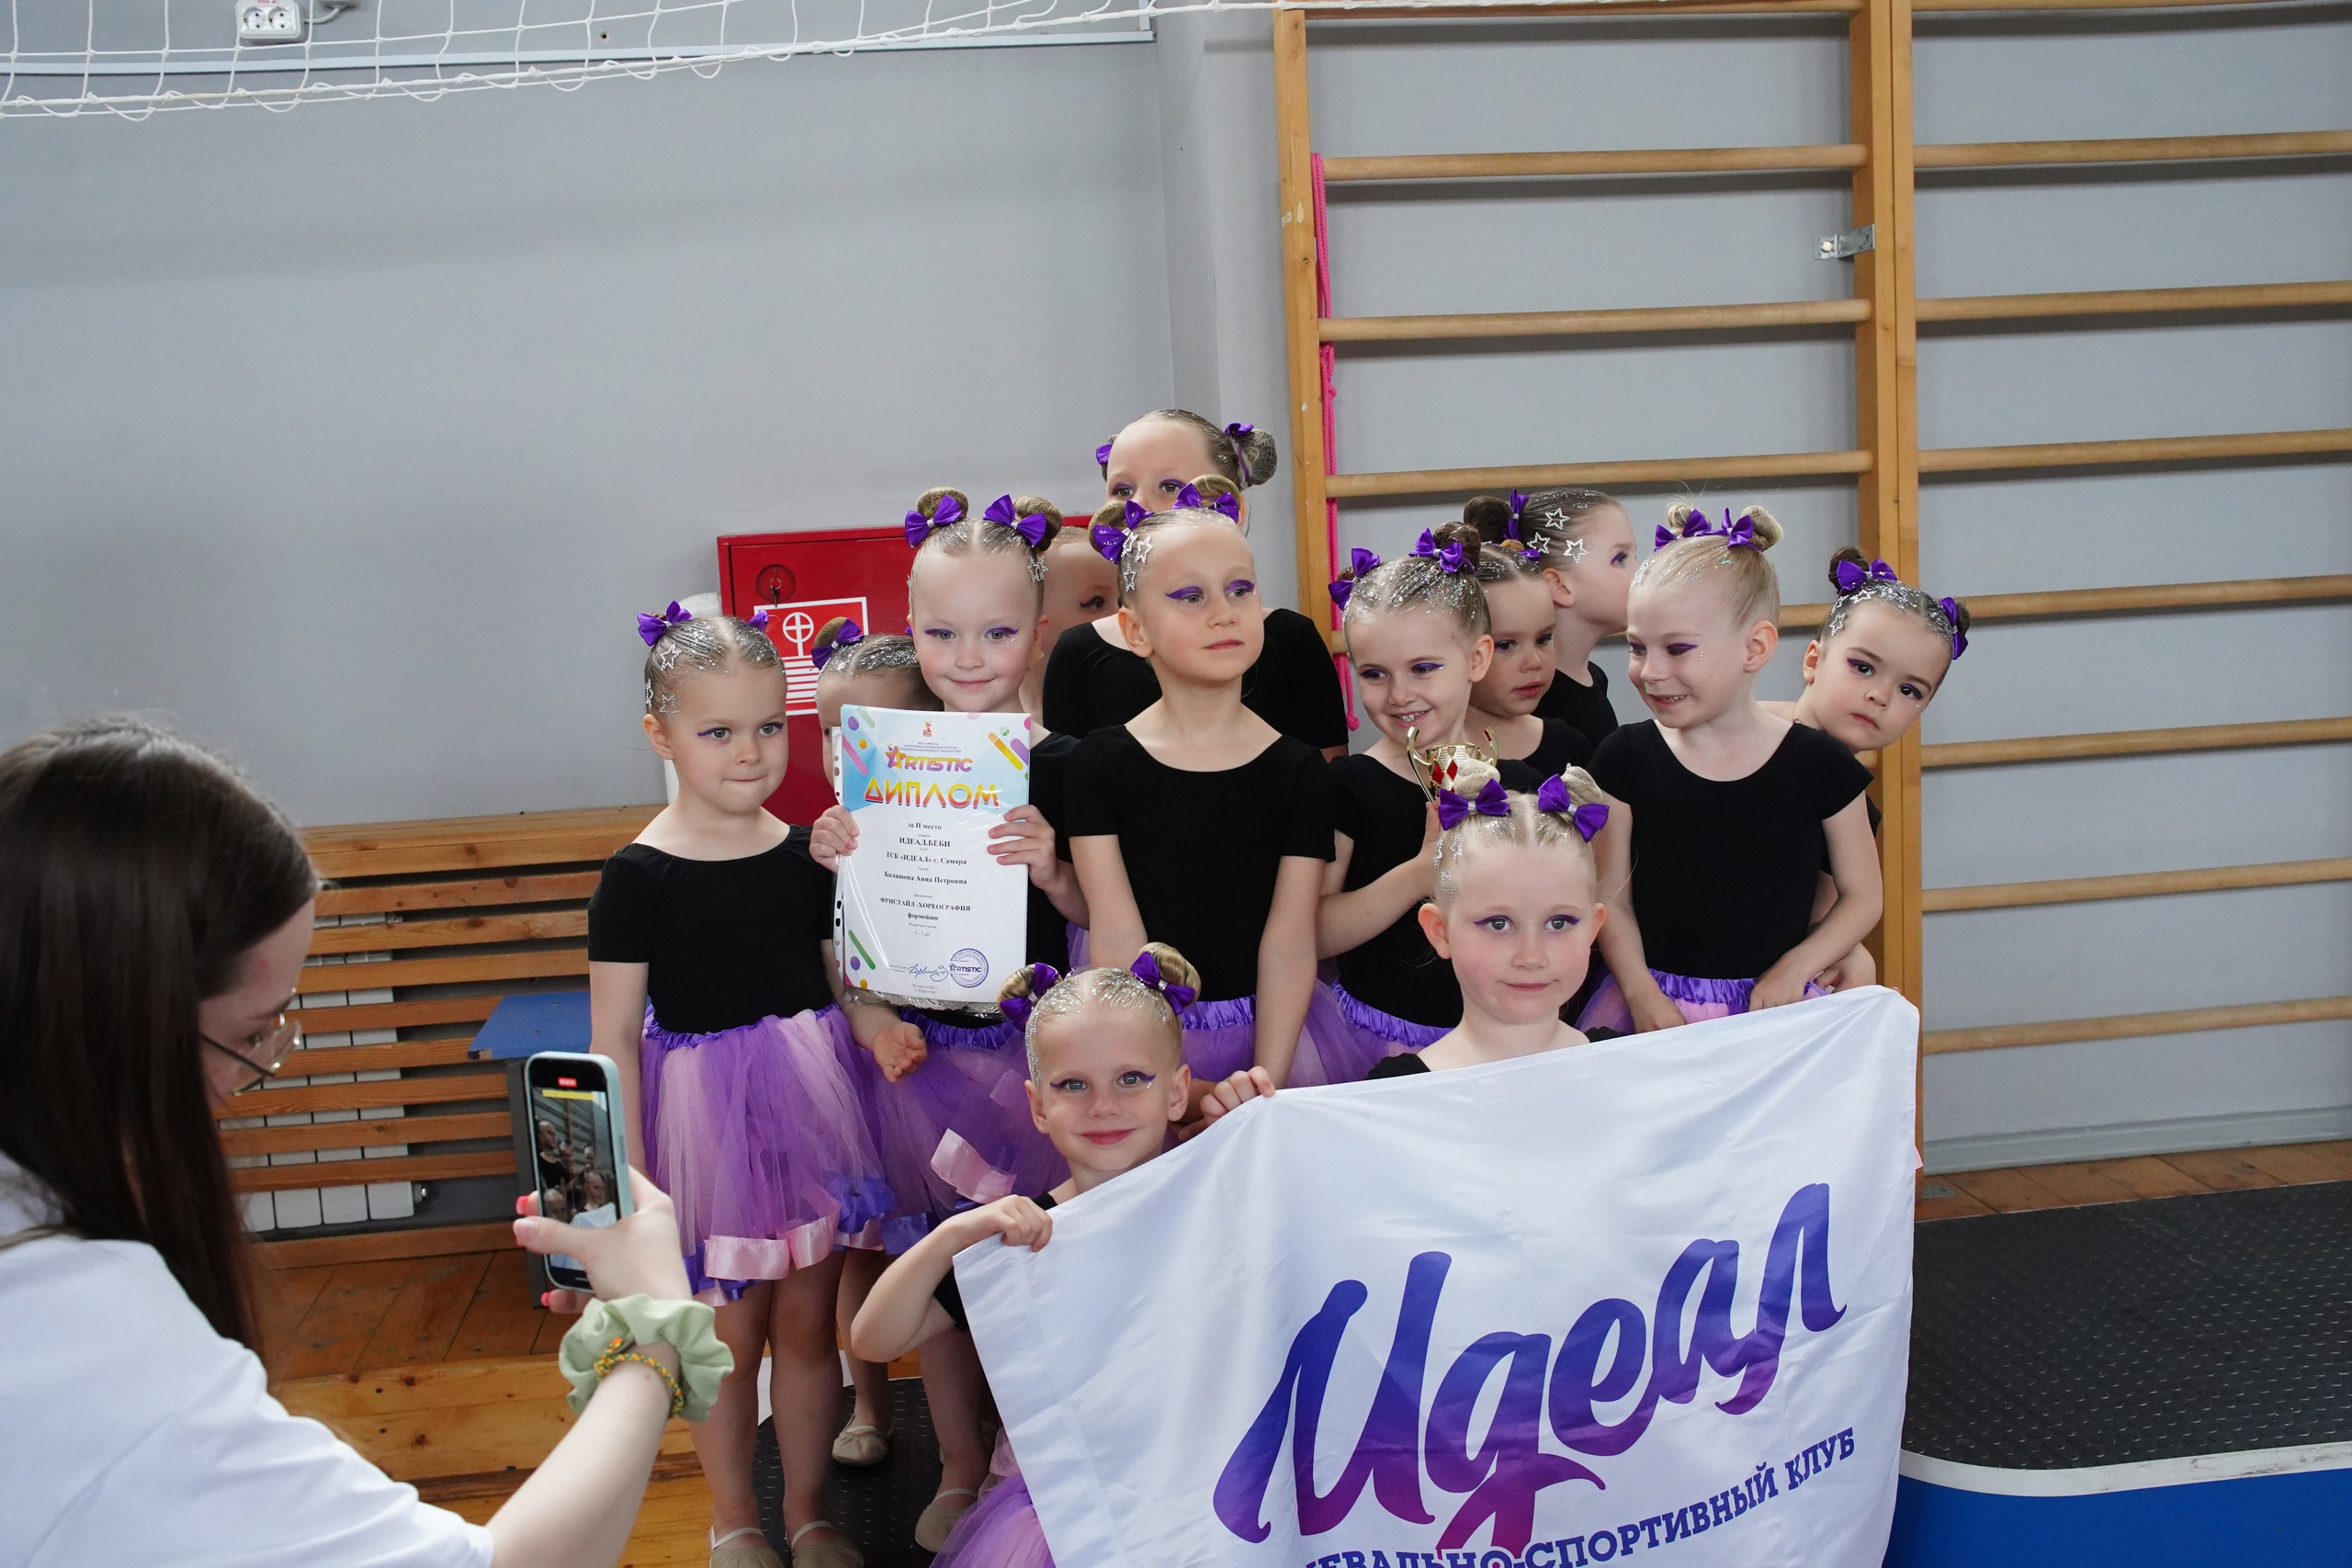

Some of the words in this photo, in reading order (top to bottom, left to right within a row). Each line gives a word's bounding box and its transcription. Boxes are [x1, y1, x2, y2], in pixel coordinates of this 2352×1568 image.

[886, 746, 973, 772] ARTISTIC
[864, 777, 1000, 809] ДИПЛОМ
[886, 852, 899, 860] ТСК
[899, 854, 932, 863] «ИДЕАЛ»
[940, 857, 967, 865] Самара
[884, 871, 914, 881] Балашова
[934, 876, 967, 885] Петровна
[880, 897, 915, 908] ФРИСТАЙЛ
[949, 963, 982, 973] ARTISTIC
[1214, 1182, 1849, 1560] Идеал
[1306, 1461, 1779, 1568] ВАЛЬНО-СПОРТИВНЫЙ
[1784, 1427, 1855, 1491] КЛУБ
